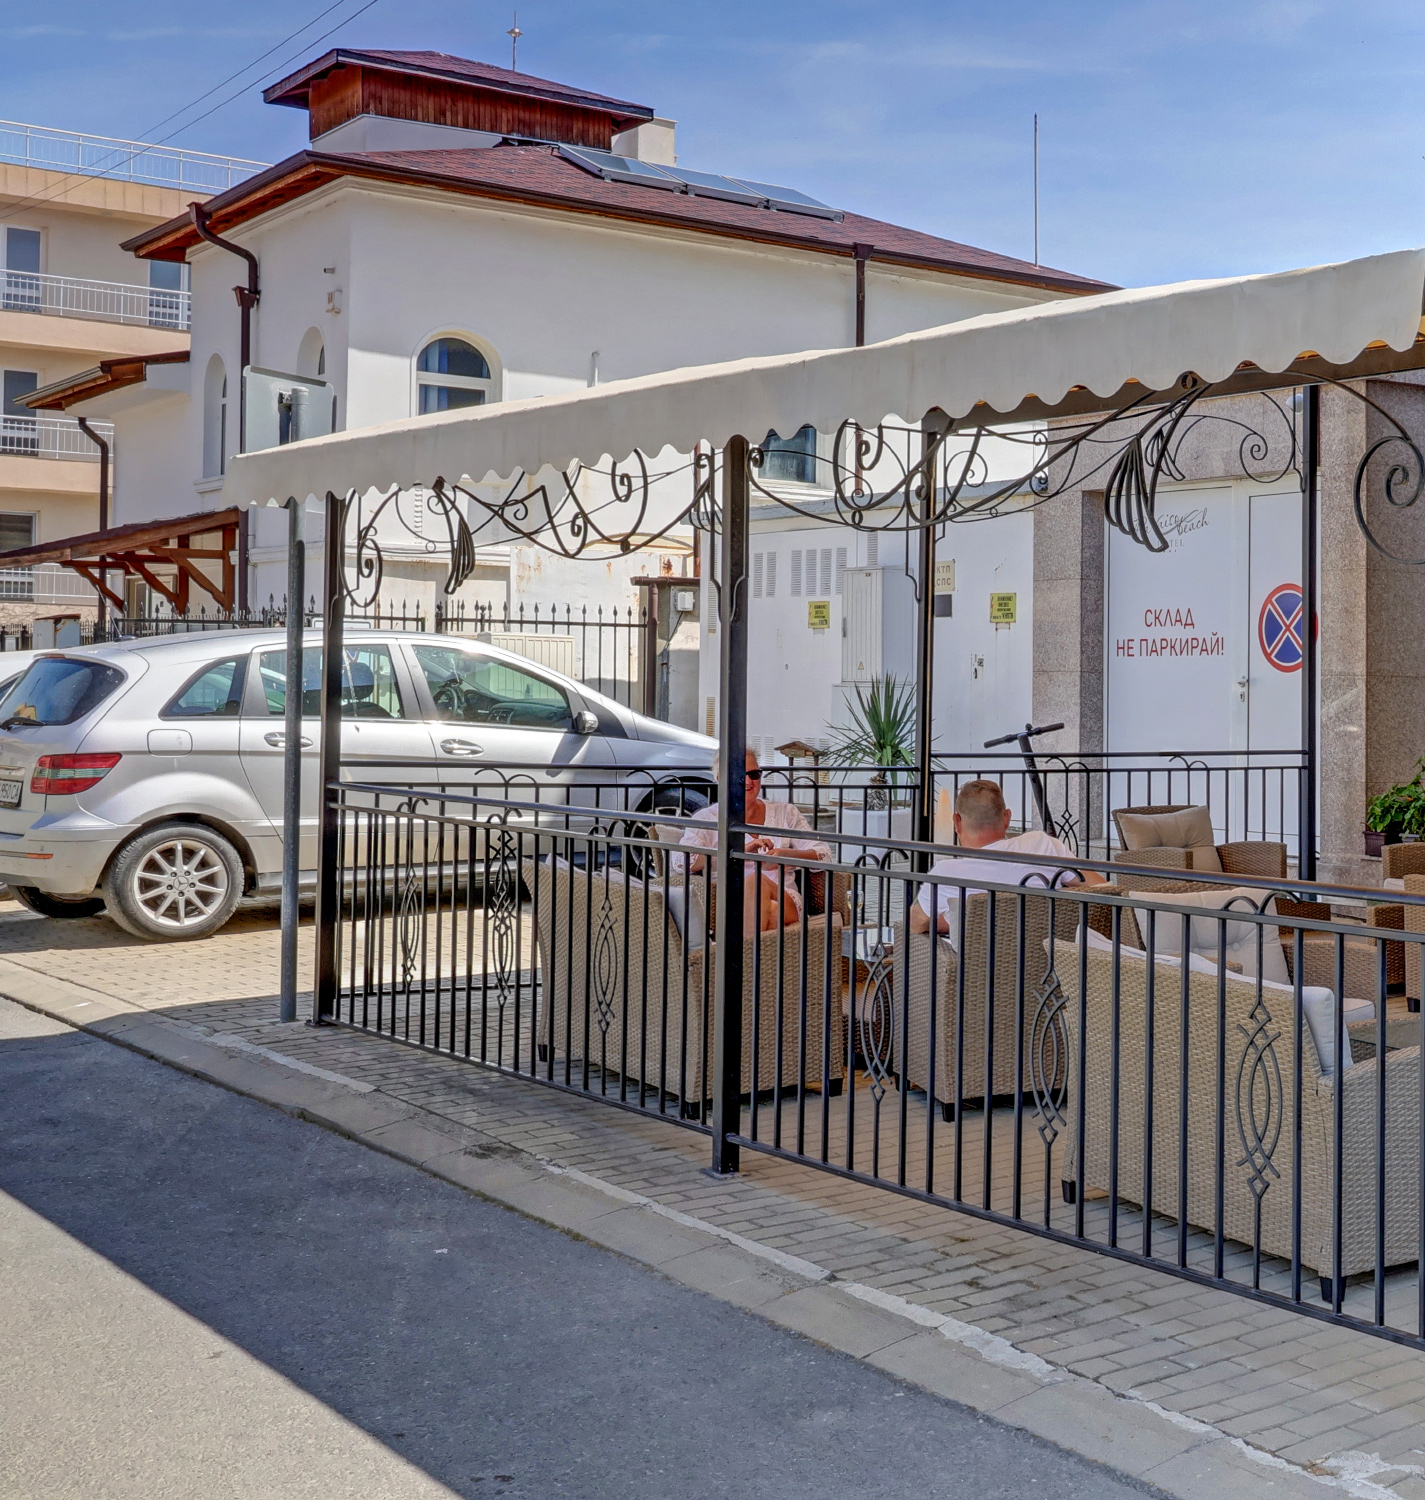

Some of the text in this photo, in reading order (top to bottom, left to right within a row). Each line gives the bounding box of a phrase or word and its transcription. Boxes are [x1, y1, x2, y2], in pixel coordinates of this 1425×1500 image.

[1157, 539, 1184, 548] TEL
[1144, 608, 1195, 629] СКЛАД
[1116, 632, 1224, 657] НЕ ПАРКИРАЙ!
